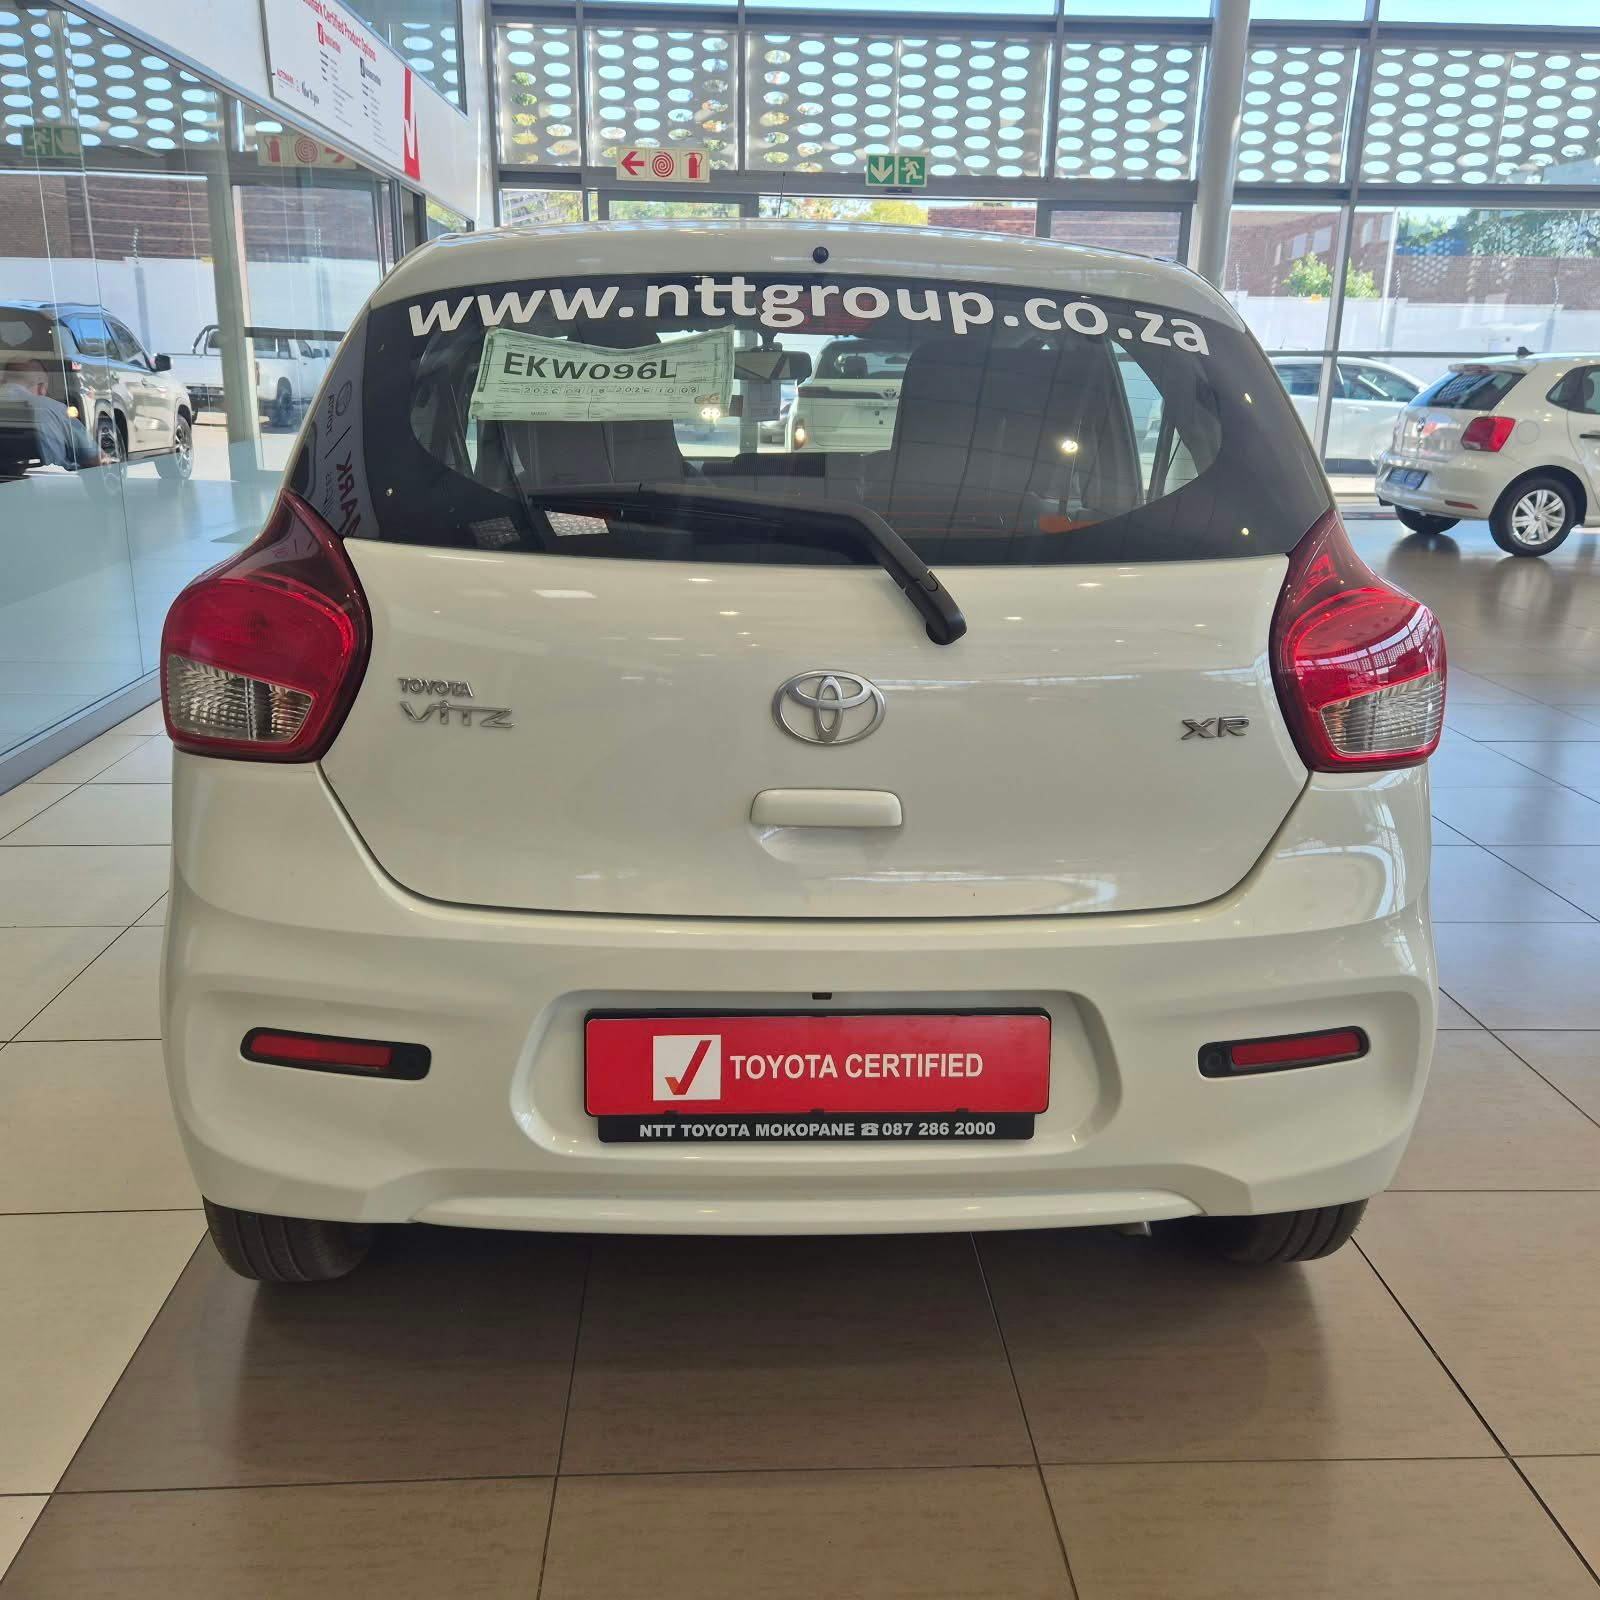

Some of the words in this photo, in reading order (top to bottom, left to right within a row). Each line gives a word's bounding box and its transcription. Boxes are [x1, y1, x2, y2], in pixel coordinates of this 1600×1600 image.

[408, 275, 1210, 356] www.nttgroup.co.za
[503, 351, 677, 380] EKW096L
[398, 678, 474, 698] TOYOTA
[1181, 715, 1250, 741] XR
[729, 1053, 838, 1080] TOYOTA
[845, 1052, 984, 1079] CERTIFIED
[639, 1123, 676, 1138] NTT
[680, 1123, 750, 1138] TOYOTA
[755, 1122, 855, 1137] MOKOPANE
[882, 1121, 913, 1137] 087
[918, 1121, 950, 1137] 286
[954, 1121, 996, 1136] 2000
